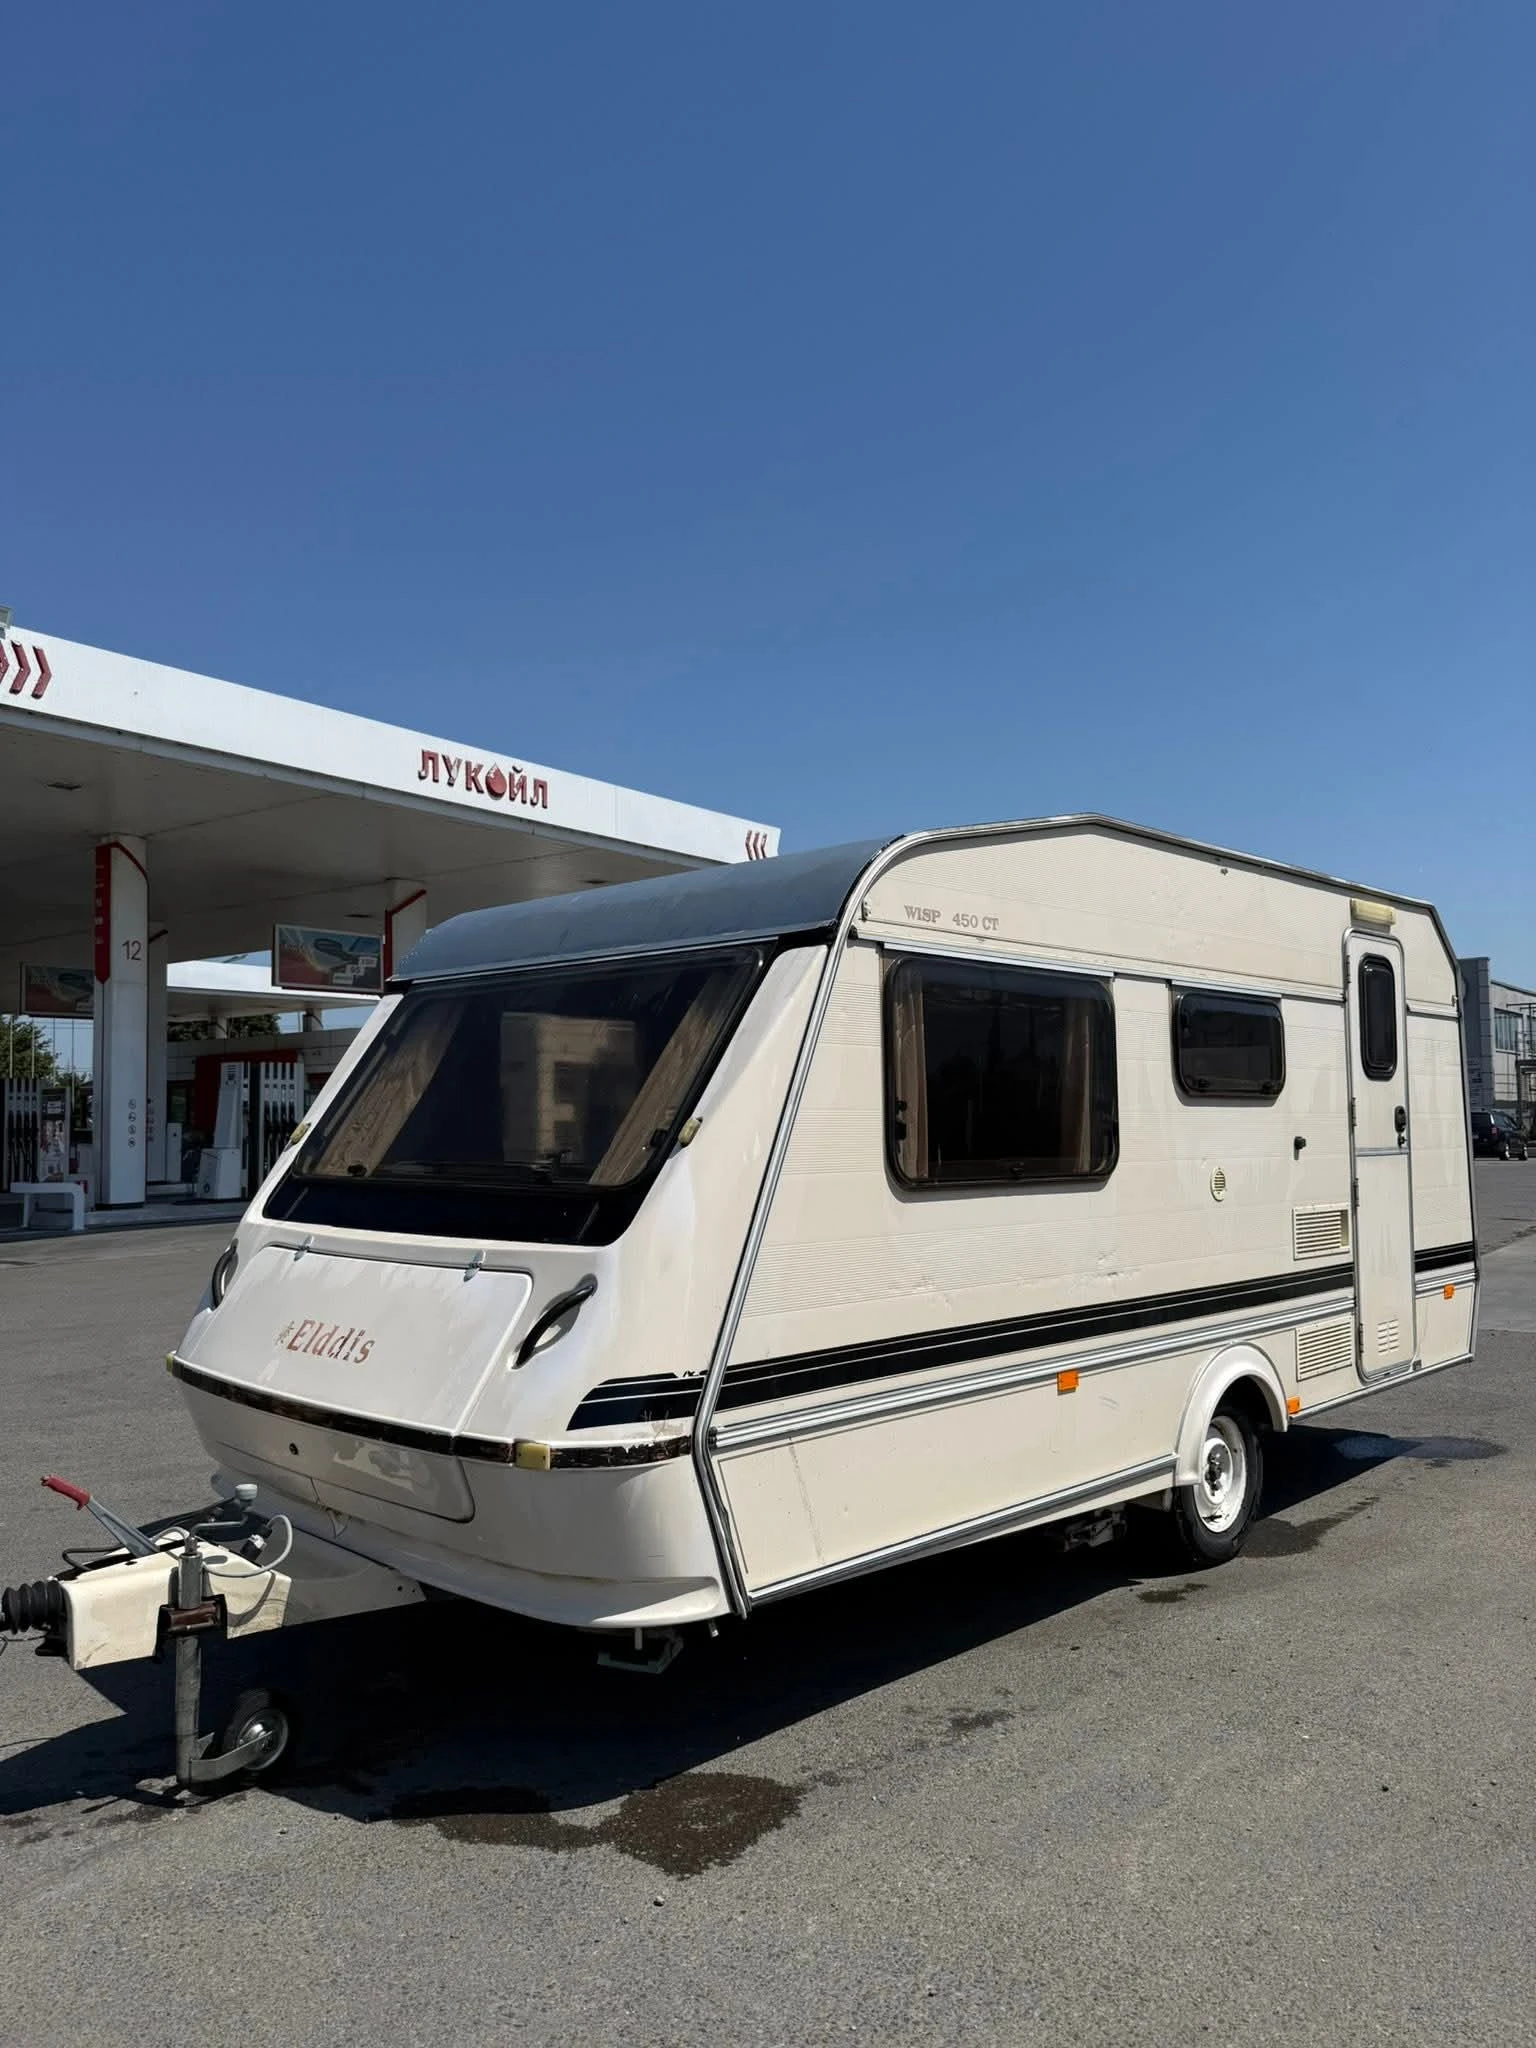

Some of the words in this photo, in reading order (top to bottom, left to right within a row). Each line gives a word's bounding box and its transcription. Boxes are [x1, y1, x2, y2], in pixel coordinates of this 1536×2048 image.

[418, 750, 548, 808] ЛУКОЙЛ
[904, 905, 941, 923] WISP
[952, 913, 978, 929] 450
[982, 916, 999, 931] CT
[122, 940, 142, 961] 12
[287, 1319, 375, 1364] Elddis
